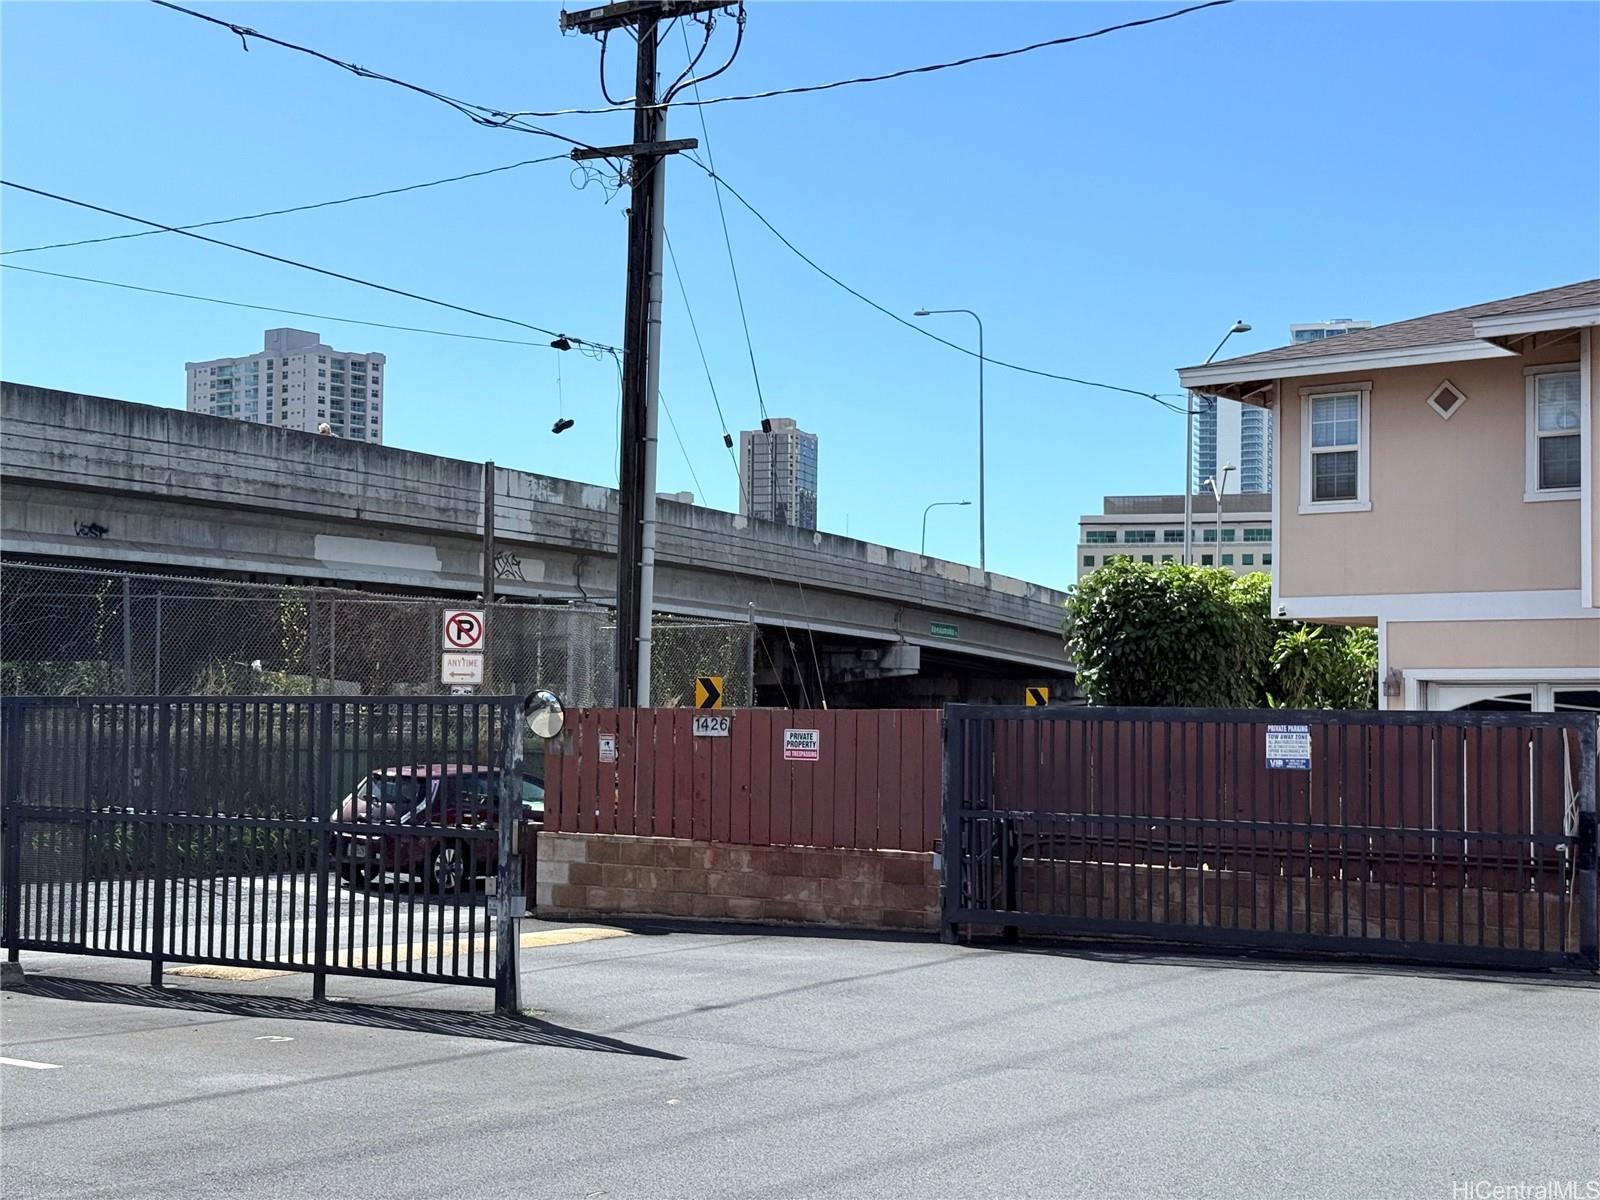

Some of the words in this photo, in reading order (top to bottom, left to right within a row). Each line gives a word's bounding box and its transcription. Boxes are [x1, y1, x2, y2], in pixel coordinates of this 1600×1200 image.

[447, 658, 480, 668] ANYTIME
[695, 717, 728, 732] 1426
[1267, 724, 1288, 733] PRIVATE
[1287, 724, 1308, 733] PARKING
[789, 732, 814, 740] PRIVATE
[786, 740, 817, 749] PROPERTY
